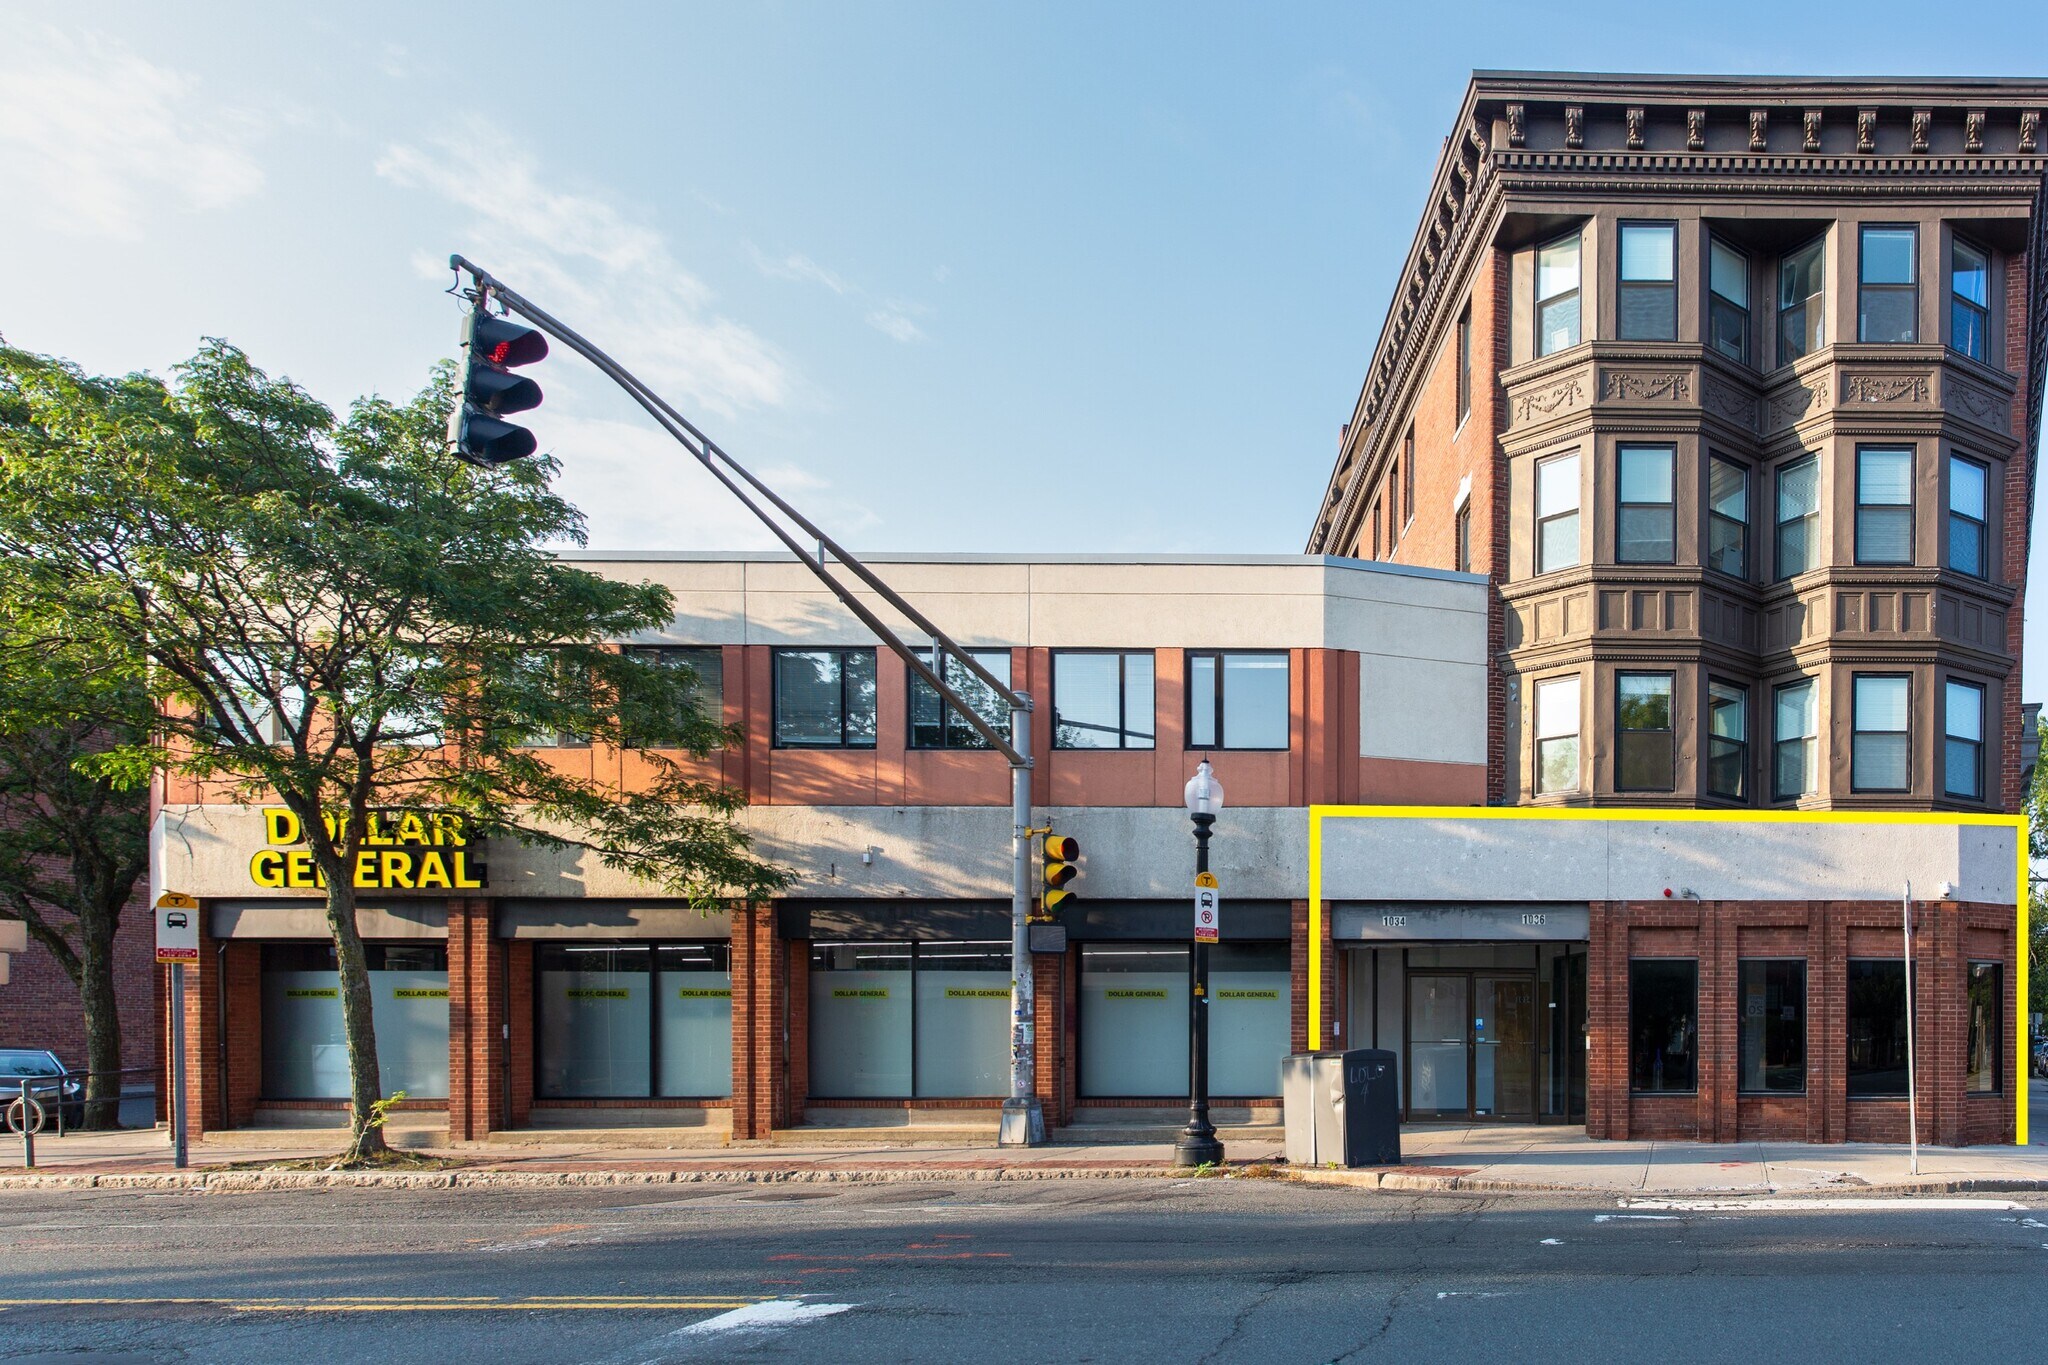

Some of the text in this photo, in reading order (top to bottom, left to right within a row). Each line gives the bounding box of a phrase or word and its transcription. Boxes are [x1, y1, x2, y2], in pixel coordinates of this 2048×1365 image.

[250, 849, 481, 888] GEERAL
[1203, 876, 1211, 885] T
[1383, 916, 1405, 926] 1034
[1523, 914, 1545, 924] 1036
